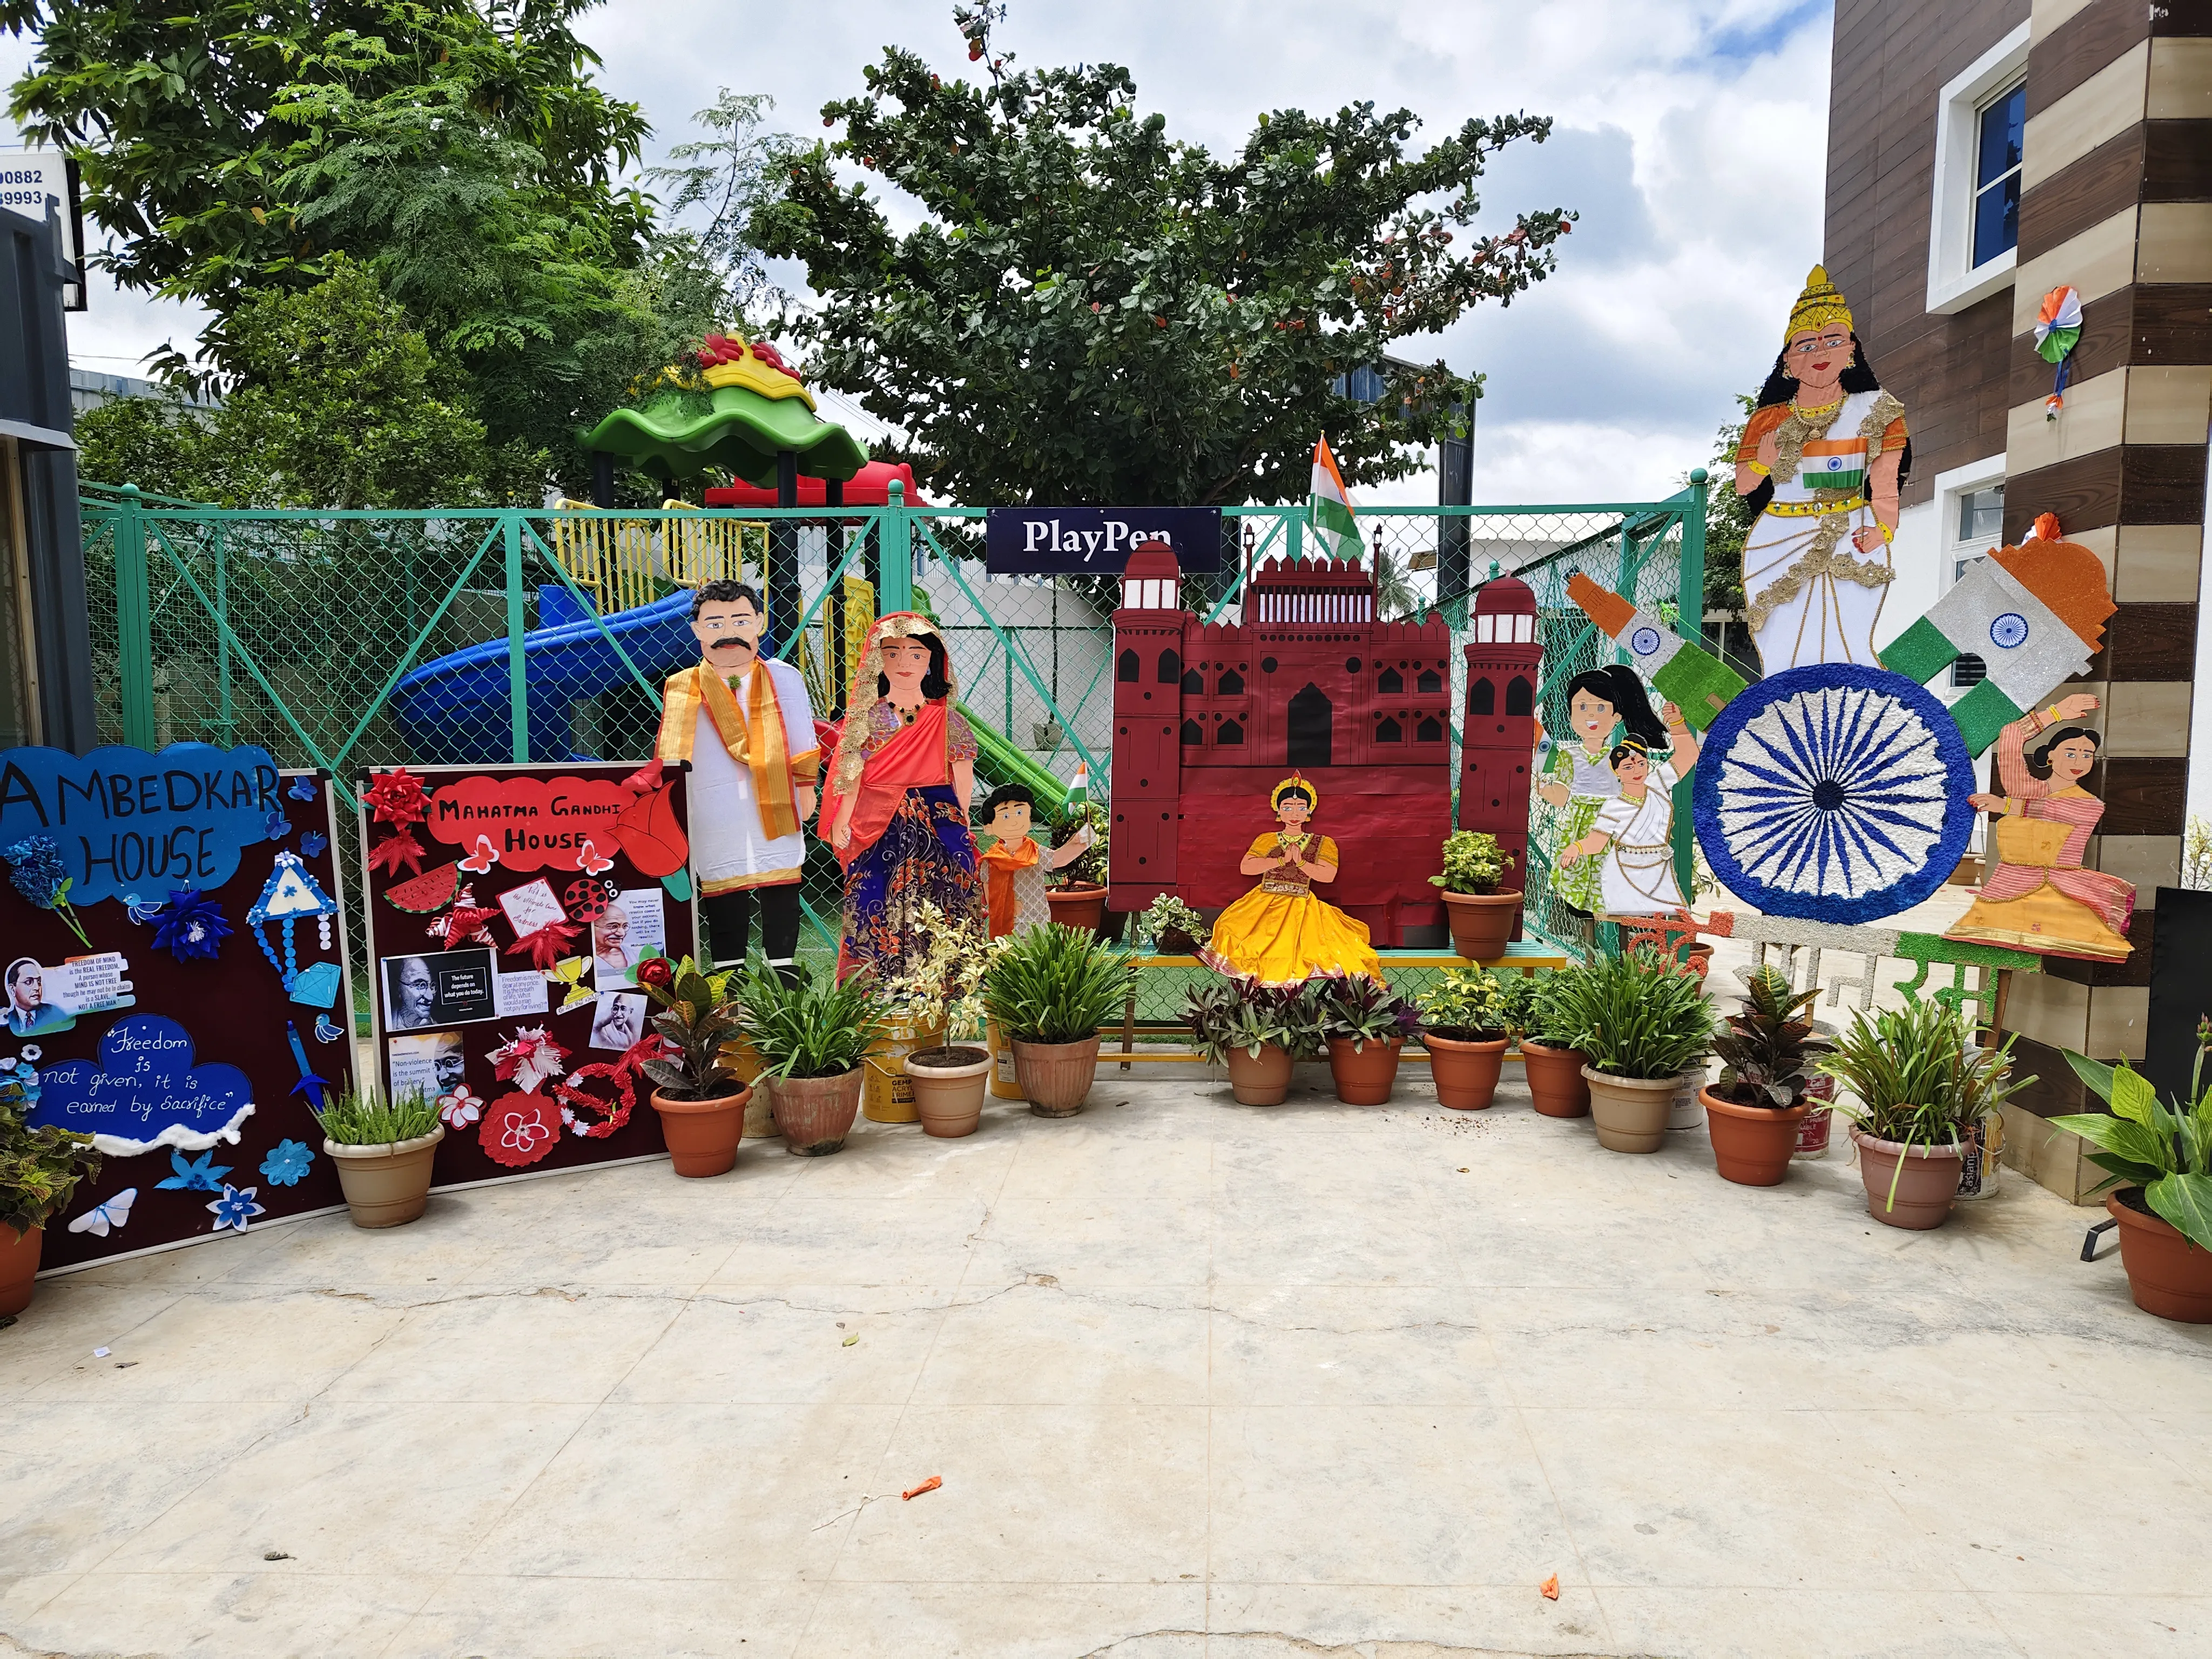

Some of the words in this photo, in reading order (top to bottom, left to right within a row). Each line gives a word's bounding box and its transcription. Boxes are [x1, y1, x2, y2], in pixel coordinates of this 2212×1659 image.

[1023, 520, 1171, 562] PlayPen
[0, 760, 283, 827] AMBEDKAR
[439, 800, 538, 821] MAHATMA
[551, 795, 621, 816] GANDHI
[505, 828, 587, 852] HOUSE
[78, 826, 215, 886] HOUSE
[528, 883, 539, 895] Red
[444, 990, 455, 998] what
[135, 1056, 150, 1073] is
[43, 1068, 79, 1084] not
[90, 1074, 142, 1096] given,
[155, 1075, 171, 1089] it
[185, 1075, 198, 1089] is
[66, 1100, 117, 1114] earned
[130, 1095, 153, 1121] by
